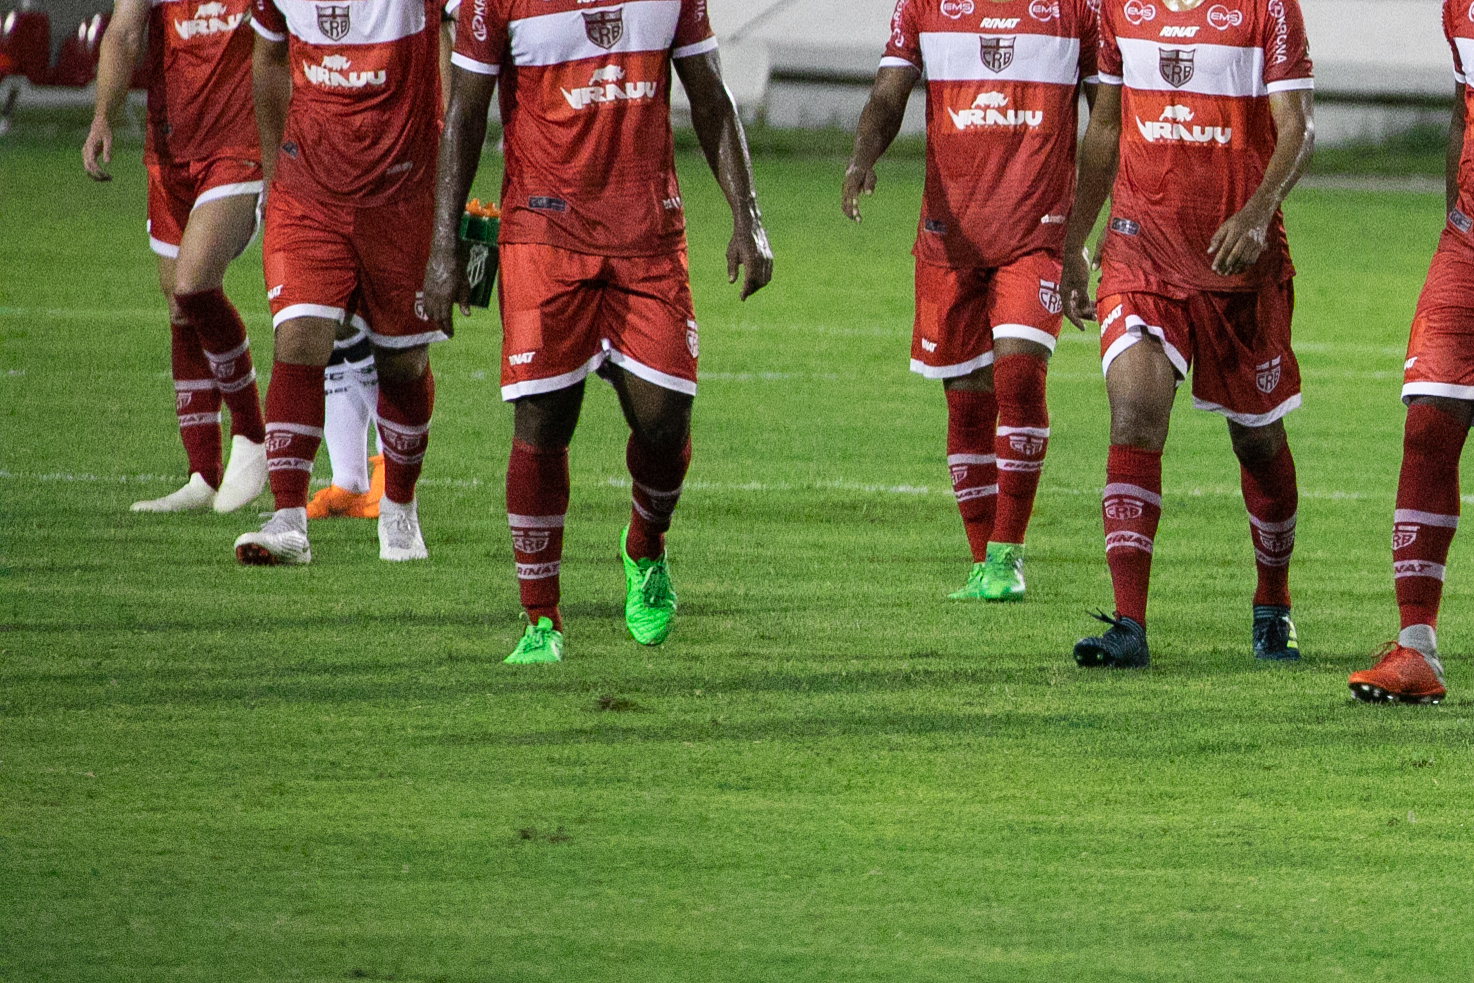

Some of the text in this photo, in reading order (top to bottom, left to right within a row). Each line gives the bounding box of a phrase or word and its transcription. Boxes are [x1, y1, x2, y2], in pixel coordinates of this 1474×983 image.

[979, 18, 1020, 29] RINAT
[1159, 25, 1200, 38] RINAT
[267, 283, 283, 300] NAT
[1395, 563, 1433, 574] NAT
